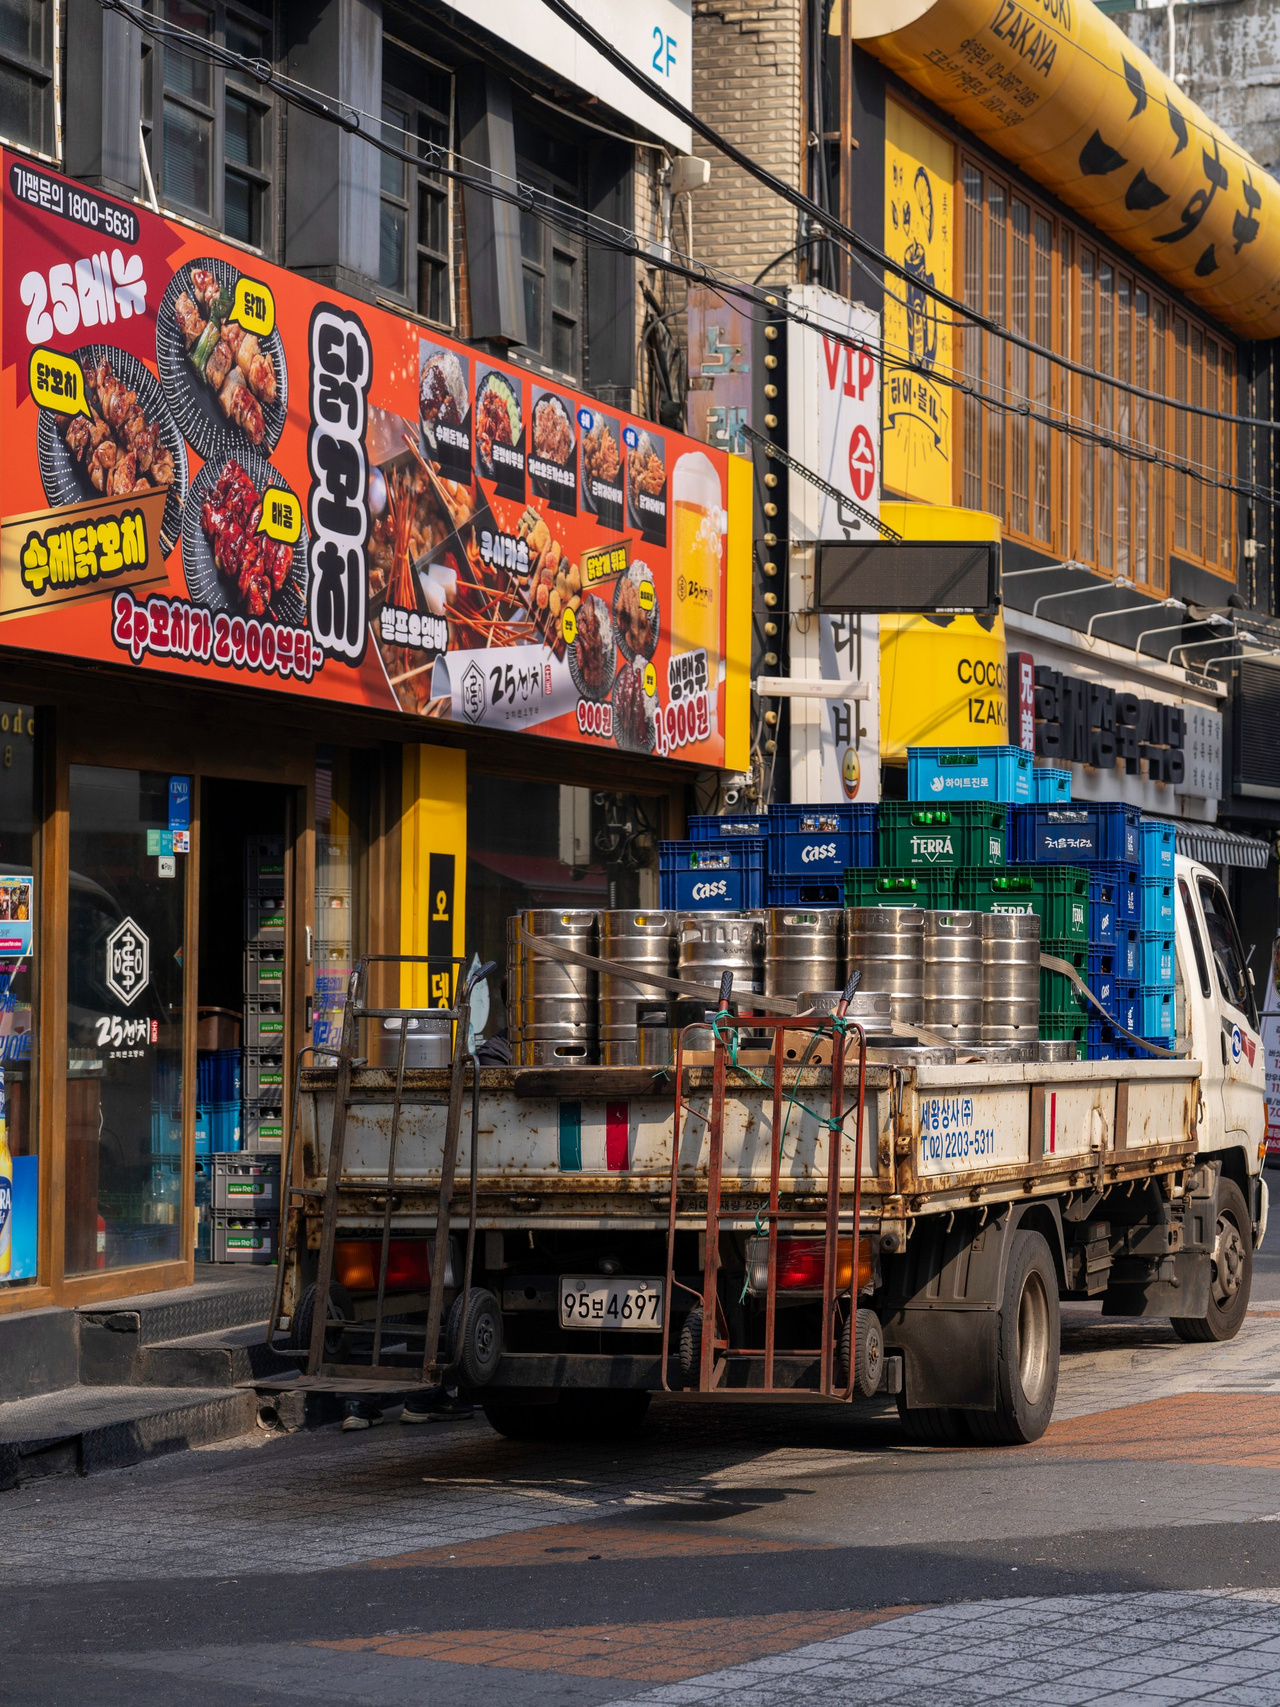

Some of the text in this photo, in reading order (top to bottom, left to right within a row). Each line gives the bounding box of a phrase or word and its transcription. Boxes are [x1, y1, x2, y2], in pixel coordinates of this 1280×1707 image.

[651, 26, 678, 78] 2F
[988, 3, 1057, 79] IZAKAYA
[13, 166, 135, 242] 가맹문의 1800-5631
[36, 361, 78, 401] 닭꼬치
[822, 336, 875, 402] VIP
[23, 513, 147, 592] 수제닭꼬치
[479, 530, 530, 575] 쿠시카츠
[610, 547, 627, 572] 튀김
[214, 613, 324, 680] 2900부터~
[668, 650, 709, 700] 생맥주
[578, 701, 613, 736] 900원
[1020, 662, 1034, 751] 兄弟
[654, 692, 711, 757] 1,900원
[945, 776, 990, 790] 하이트진로
[801, 842, 837, 864] Cass
[910, 838, 954, 855] TERRA
[989, 840, 1001, 857] TERRA
[1045, 835, 1093, 849] 처음처럼
[692, 879, 727, 901] Cass
[920, 1097, 974, 1131] 세왕상사(주)
[945, 1127, 996, 1158] 2203-5311
[745, 1199, 792, 1213] 250kg
[564, 1293, 660, 1320] 95보4697
